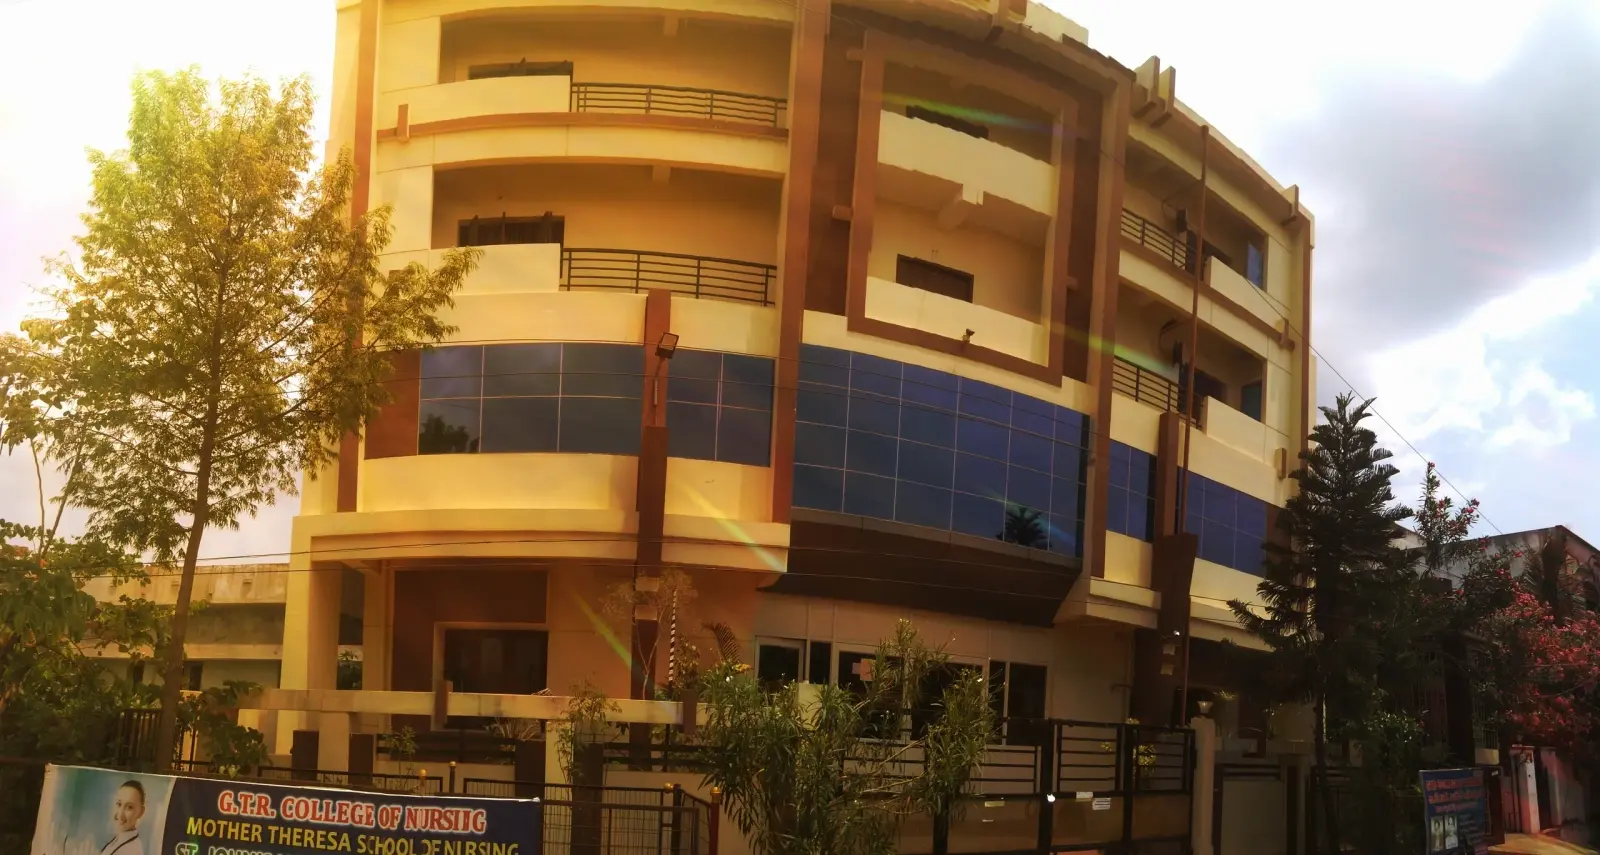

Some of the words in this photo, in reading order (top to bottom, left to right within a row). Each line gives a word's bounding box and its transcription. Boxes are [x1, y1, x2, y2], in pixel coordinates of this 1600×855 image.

[218, 790, 276, 818] G.T.R.
[281, 797, 374, 828] COLLEGE
[378, 805, 402, 829] OF
[186, 817, 262, 843] MOTHER
[268, 825, 351, 852] THERESA
